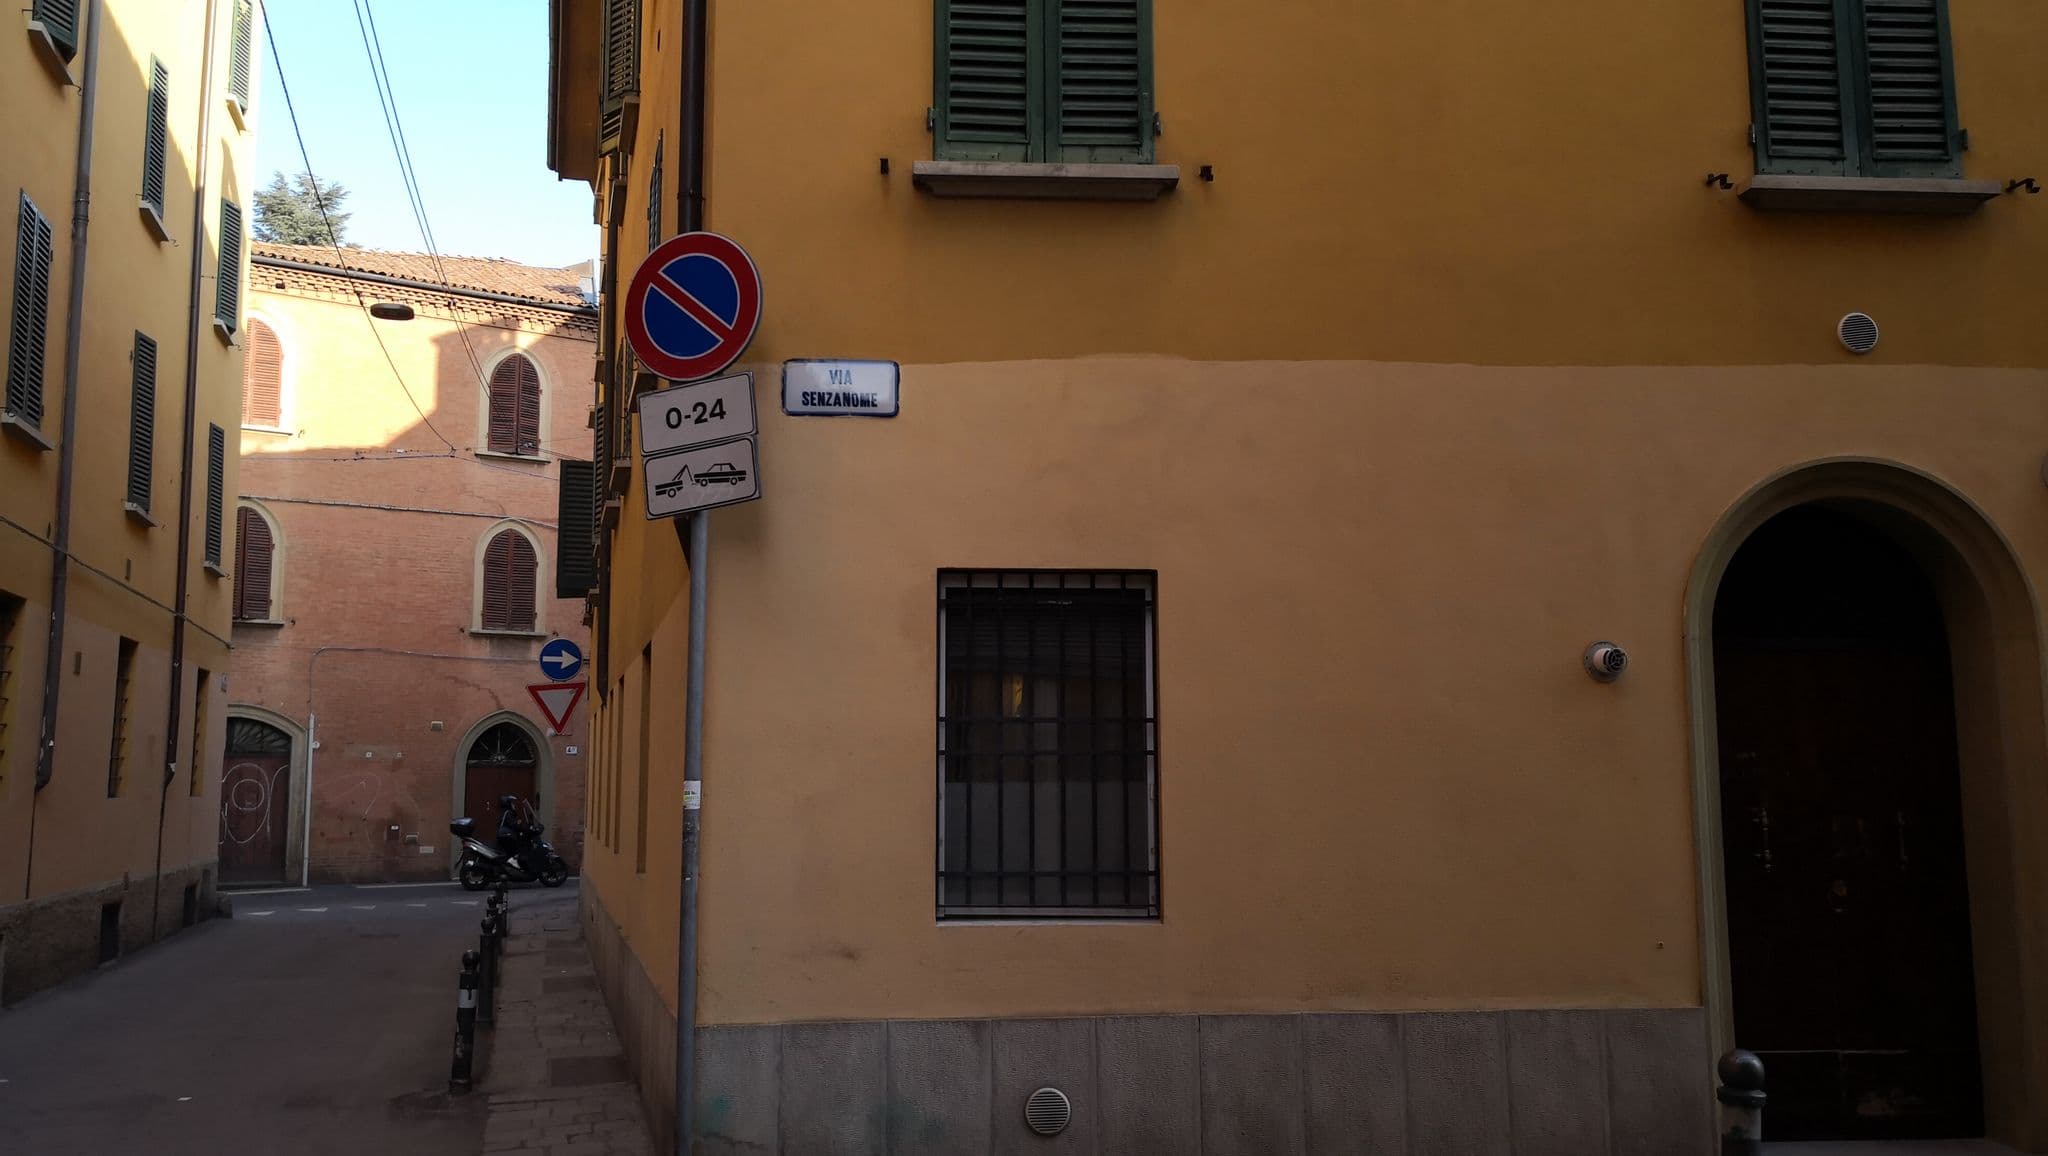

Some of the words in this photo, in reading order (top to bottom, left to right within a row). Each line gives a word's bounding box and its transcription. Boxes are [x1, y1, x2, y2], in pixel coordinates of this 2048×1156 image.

[829, 369, 853, 385] VIA
[802, 391, 878, 408] SENZANOME
[665, 397, 727, 429] 0-24
